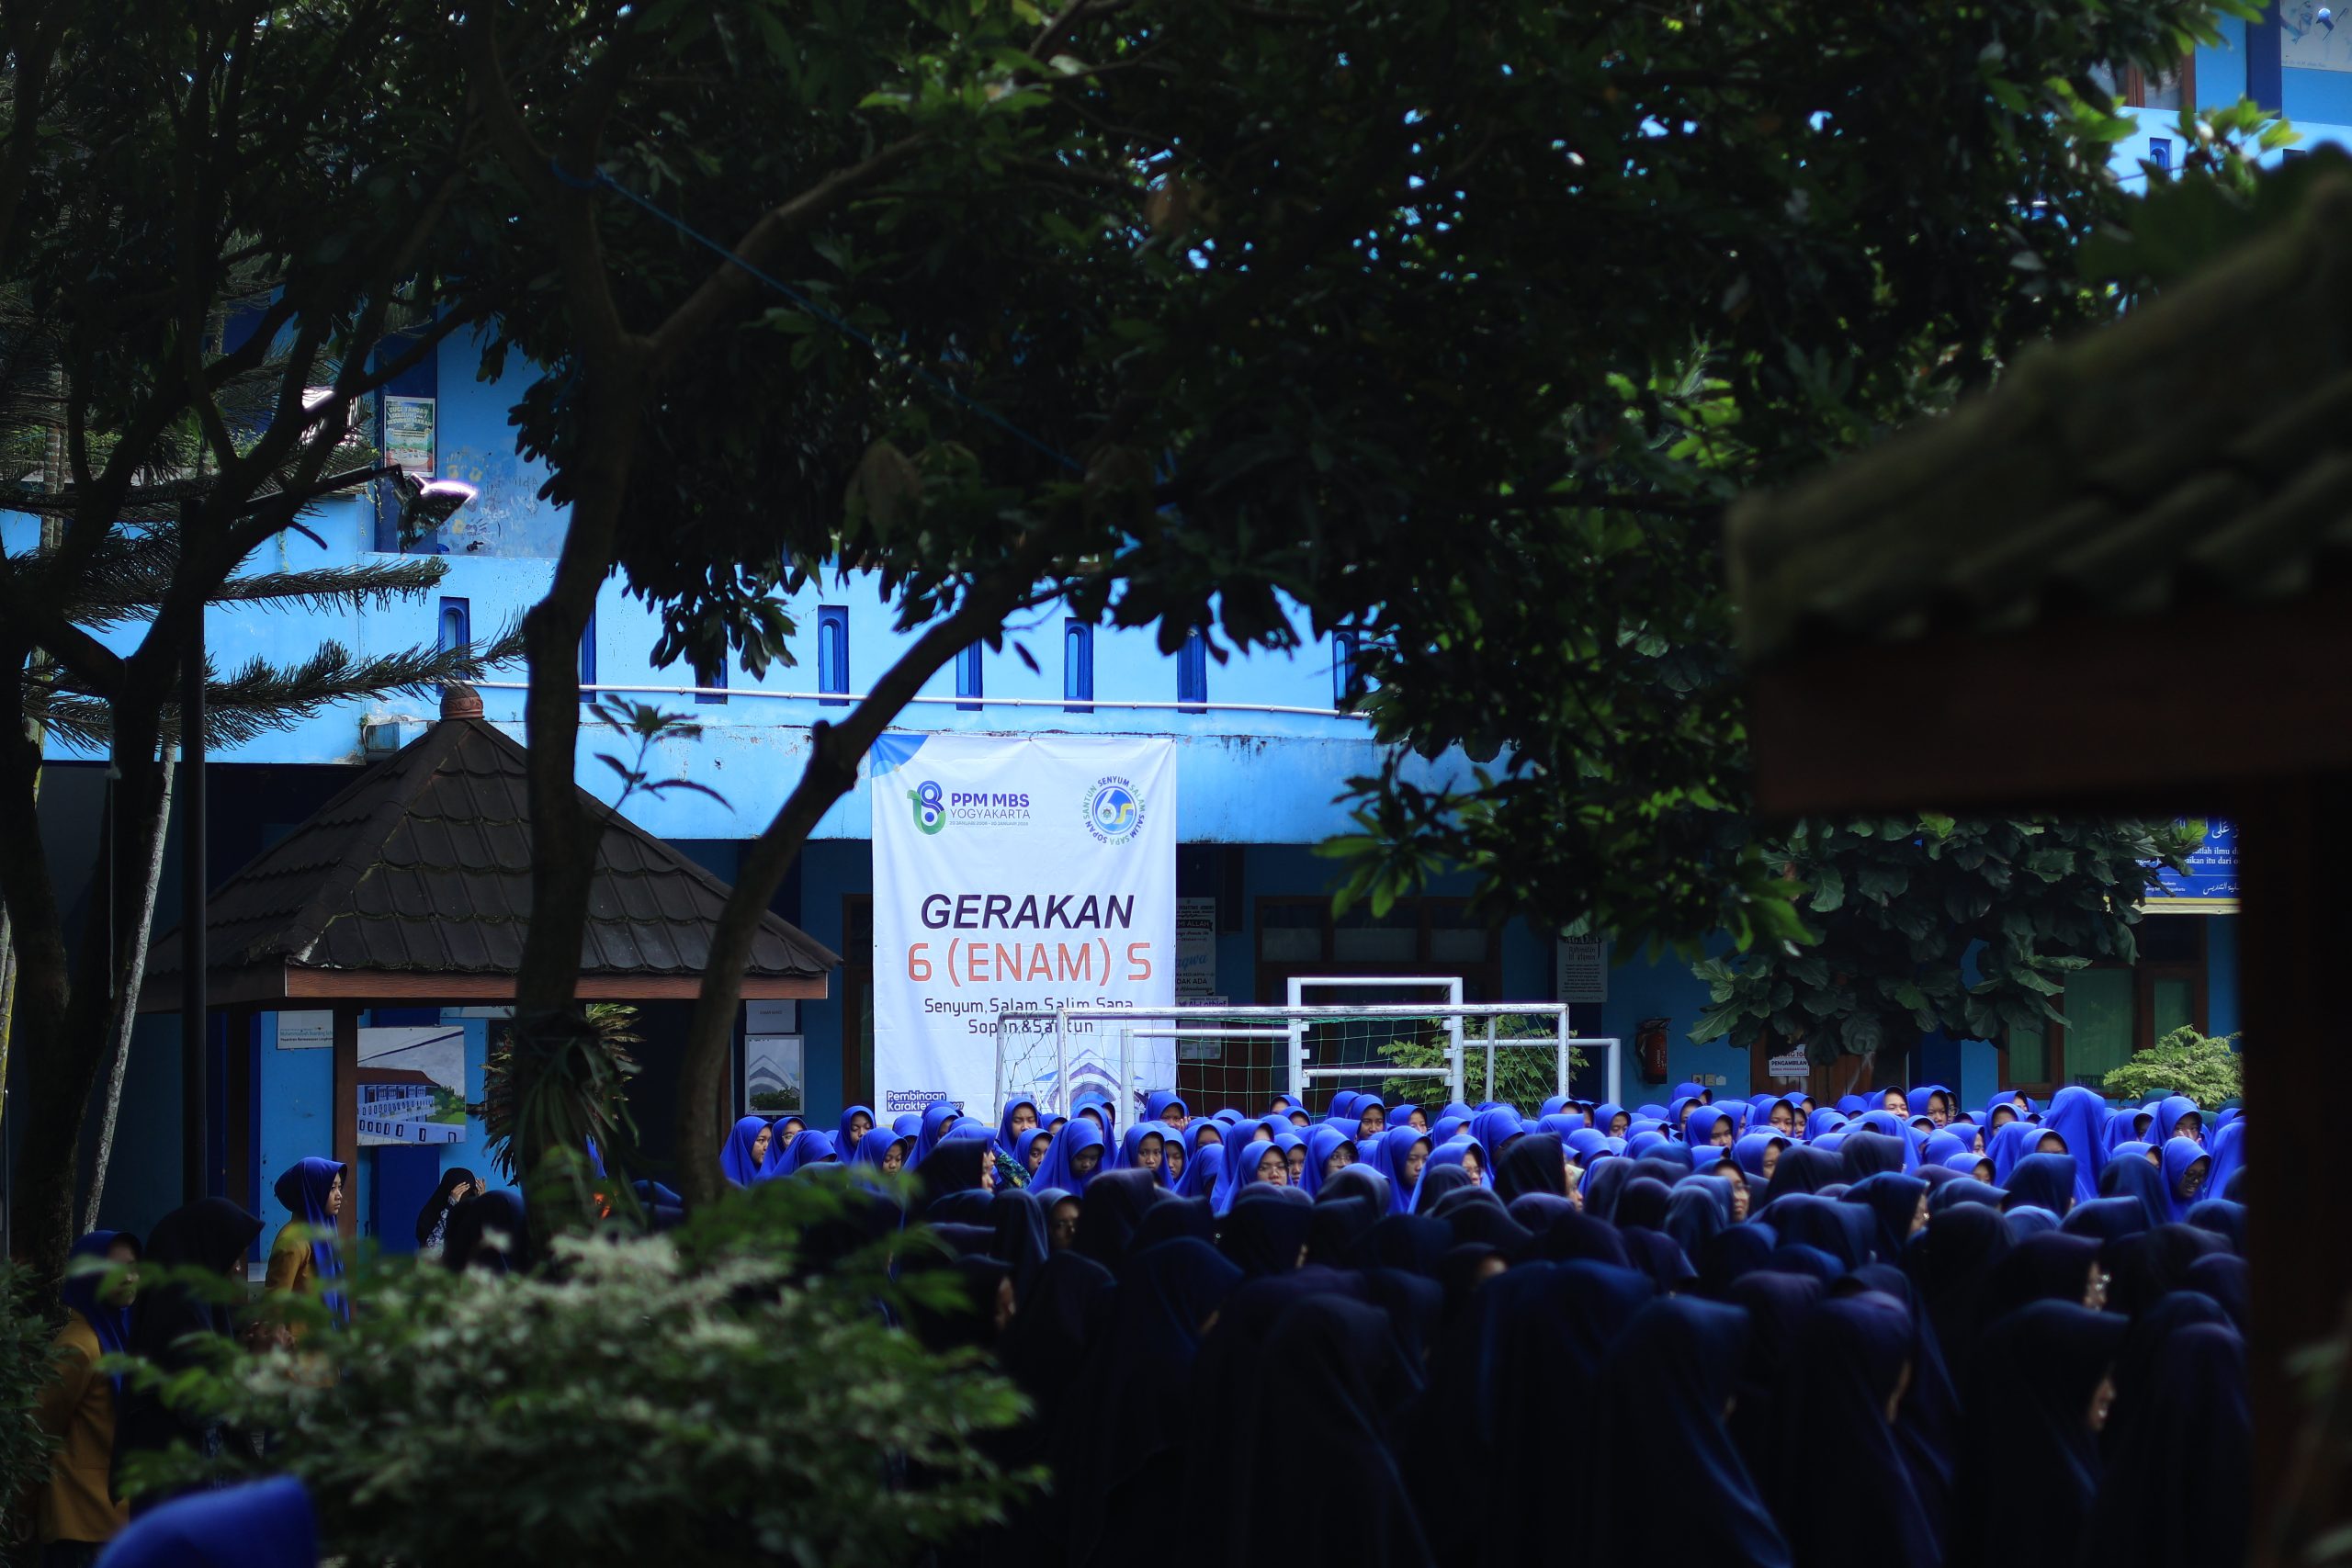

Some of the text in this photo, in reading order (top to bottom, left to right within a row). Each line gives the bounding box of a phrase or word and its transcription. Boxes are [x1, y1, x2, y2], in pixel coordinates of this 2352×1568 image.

[1097, 775, 1130, 787] SENYUM
[951, 793, 1030, 807] PPM MBS
[1082, 784, 1097, 819] SANTUN
[1129, 784, 1146, 812] SALAM
[950, 808, 1031, 819] YOGYAKARTA
[1085, 820, 1108, 844] SOPAN
[1130, 814, 1145, 838] SALIM
[1110, 835, 1130, 846] SAPA
[2213, 846, 2230, 855] ilmu
[2184, 856, 2204, 864] aikan
[2206, 856, 2216, 864] itu
[2217, 856, 2232, 864] dari
[921, 893, 1135, 930] GERAKAN
[908, 937, 1152, 987] 6 (ENAM) S
[924, 998, 988, 1017] Senyum,
[887, 1090, 946, 1101] Pembinaan
[887, 1101, 931, 1111] Karakter
